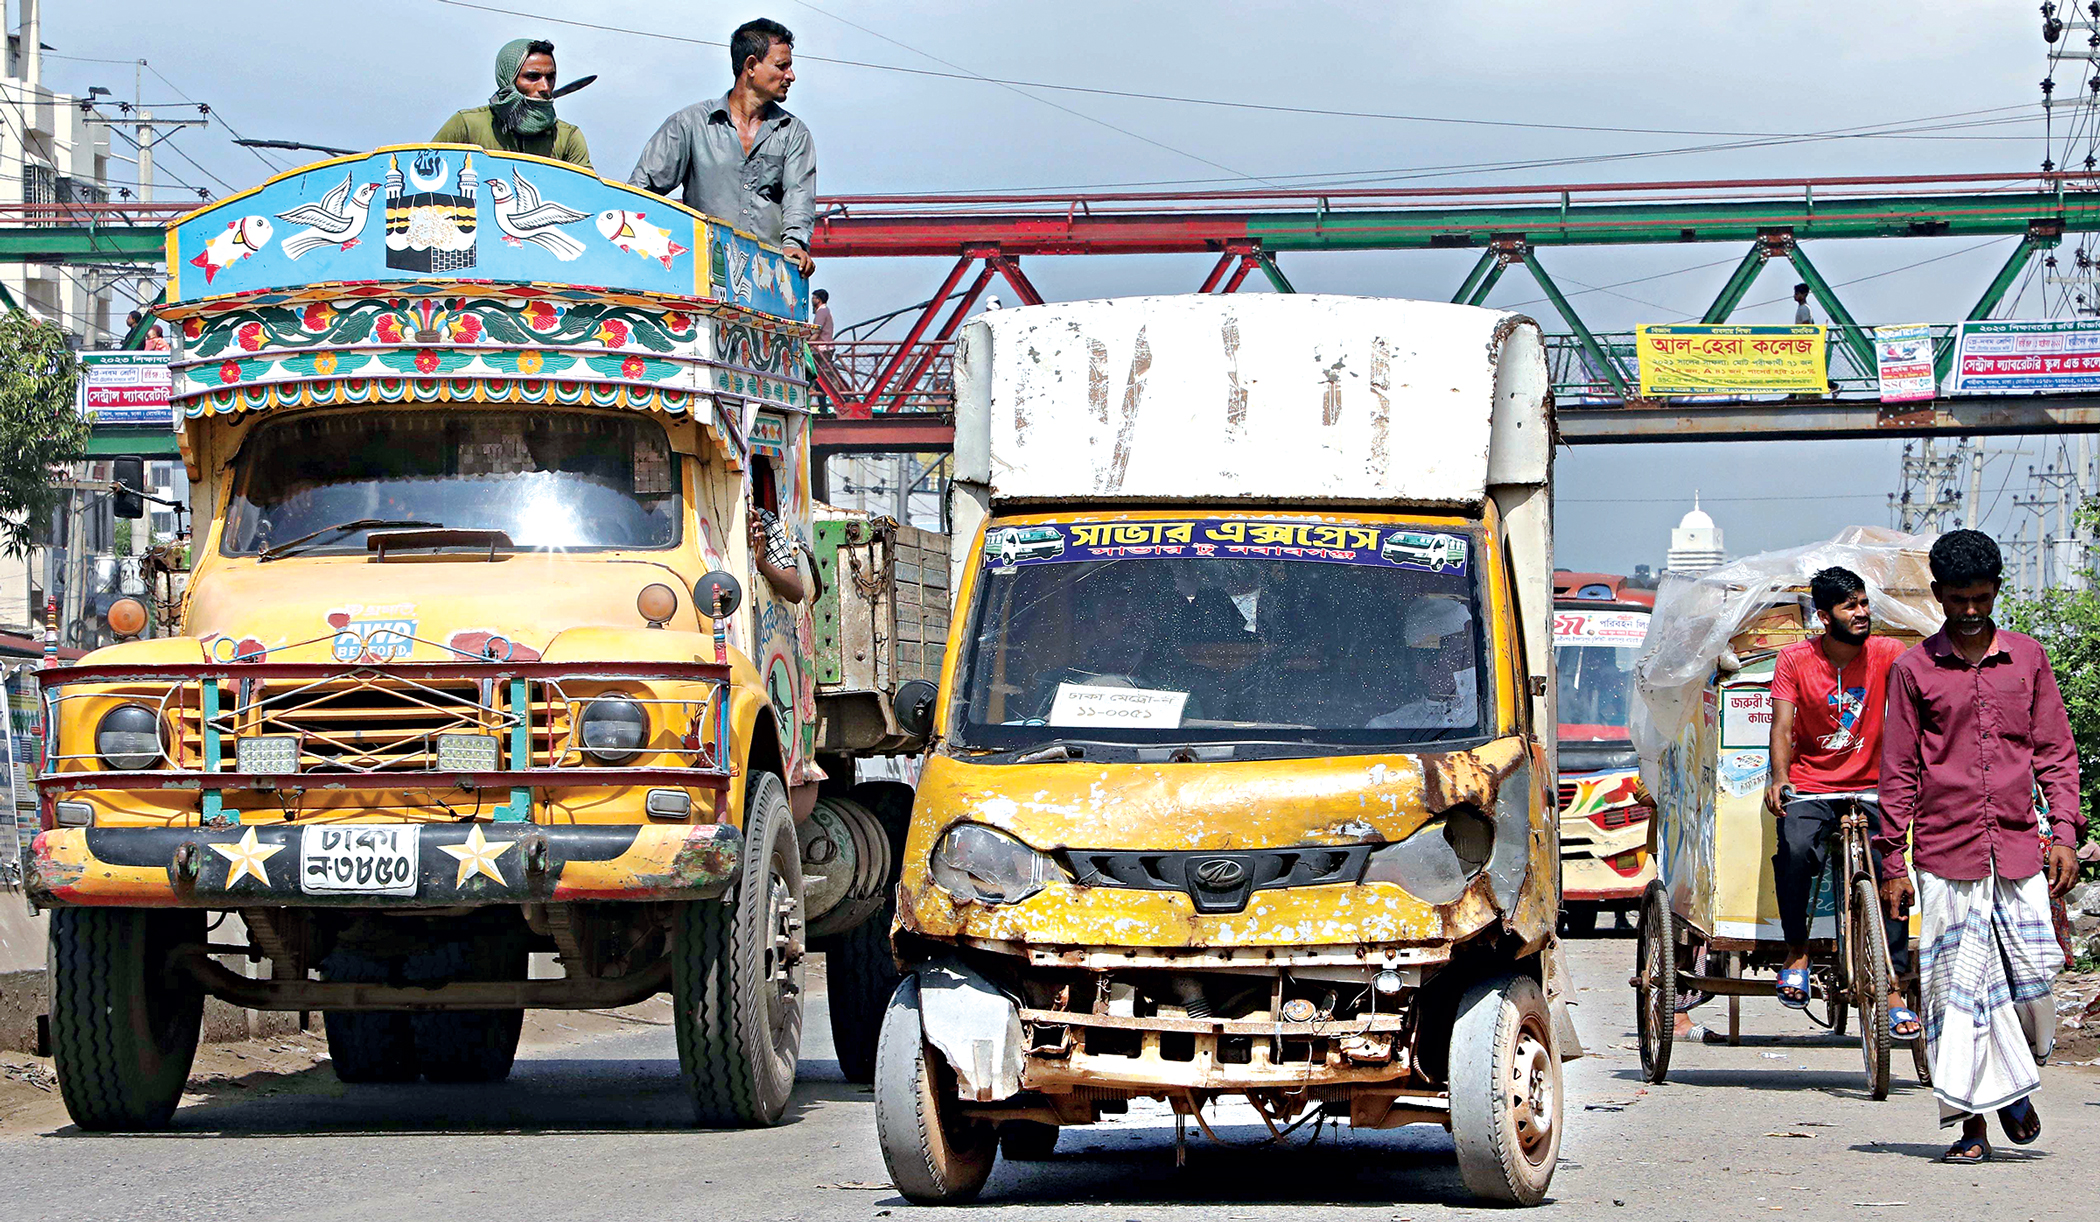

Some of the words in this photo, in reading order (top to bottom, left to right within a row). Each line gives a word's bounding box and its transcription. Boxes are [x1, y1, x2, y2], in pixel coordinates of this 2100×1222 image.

[1650, 337, 1745, 357] আল-হেরা
[1750, 339, 1815, 355] কলেজ
[1997, 355, 2042, 371] ল্যাবরেটরি
[2044, 357, 2061, 374] স্কুল
[1069, 521, 1196, 547] সাভার
[1204, 520, 1381, 551] এক্সপ্রেস
[1087, 544, 1187, 557] সাভার
[1191, 542, 1216, 557] টু
[1225, 545, 1357, 560] নবাবগঞ্জ
[1600, 617, 1633, 629] পরিবহন
[337, 622, 412, 645] AWD
[1068, 692, 1105, 700] ঢাকা
[1730, 693, 1763, 709] জরুরী
[1077, 706, 1152, 718] ১১-০০৫১
[321, 828, 399, 853] ঢাকা
